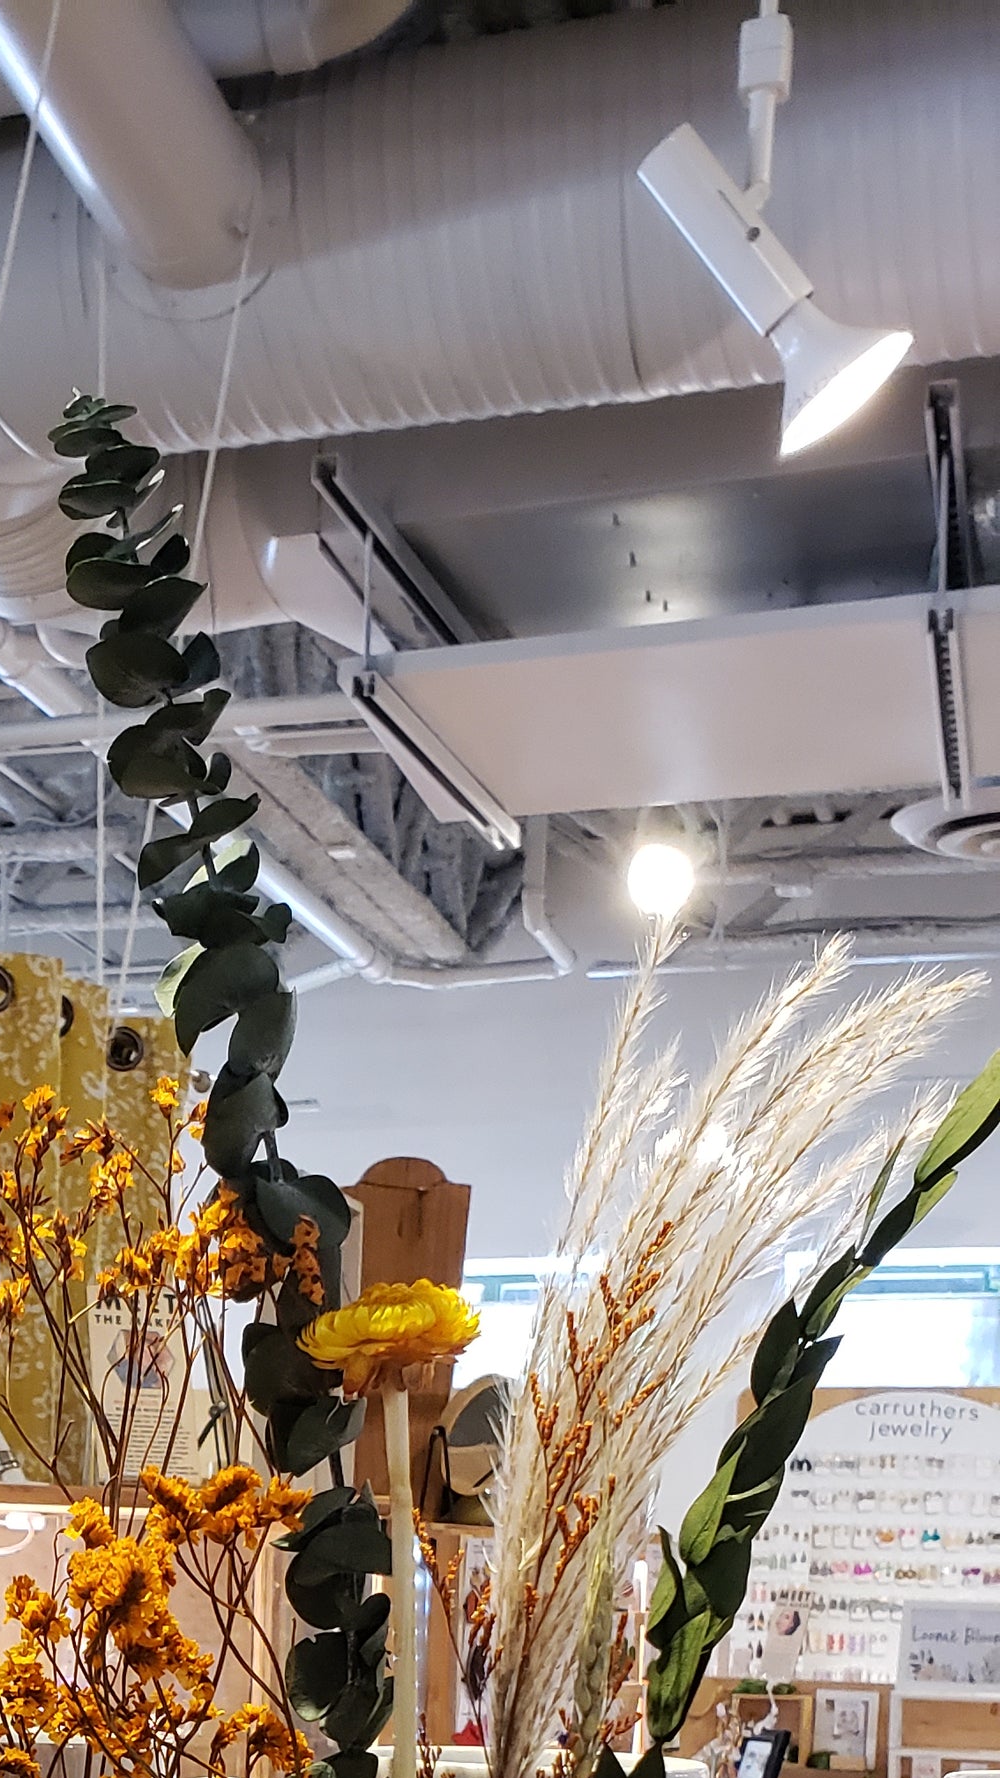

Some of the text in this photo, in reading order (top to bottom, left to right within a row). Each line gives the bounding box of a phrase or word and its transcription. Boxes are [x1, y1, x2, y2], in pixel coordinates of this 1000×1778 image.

[96, 1291, 177, 1314] MT
[94, 1314, 122, 1325] THE
[855, 1400, 979, 1421] carruthers
[869, 1420, 952, 1444] jewelry
